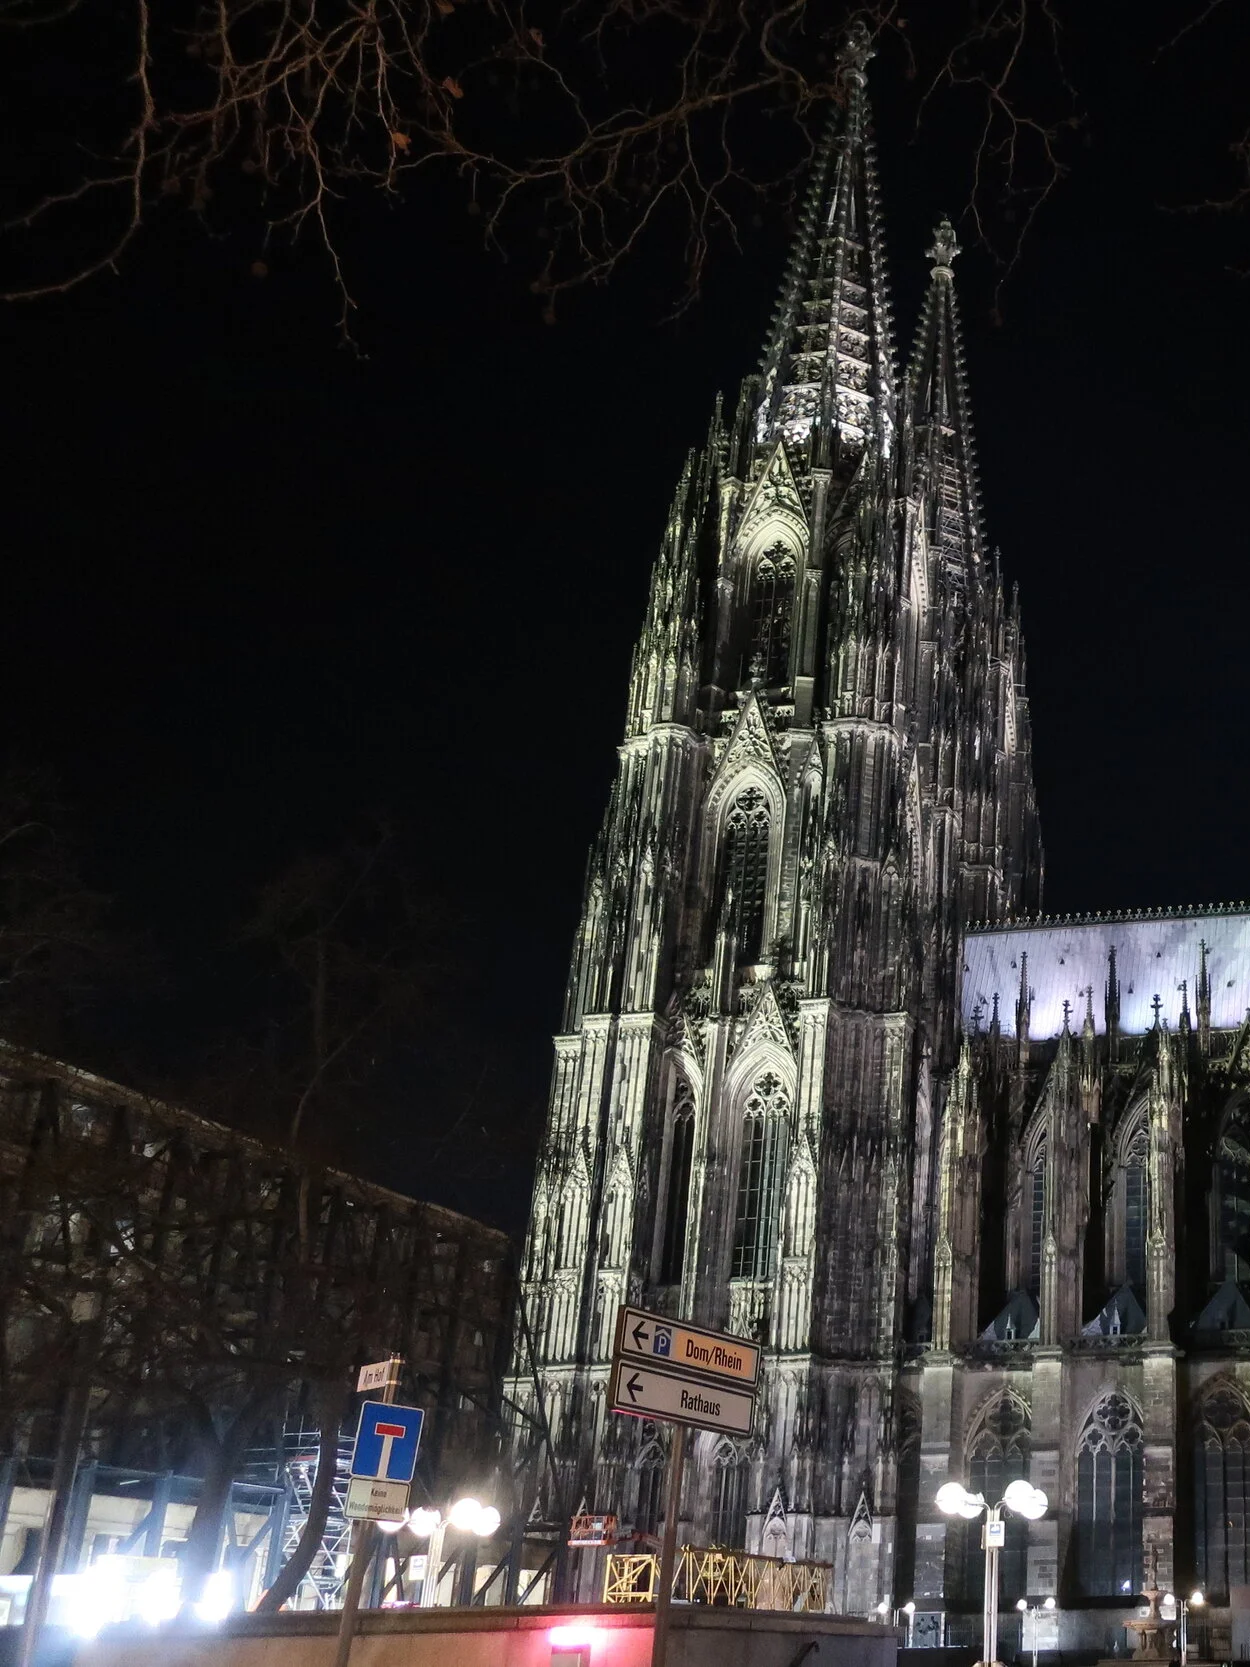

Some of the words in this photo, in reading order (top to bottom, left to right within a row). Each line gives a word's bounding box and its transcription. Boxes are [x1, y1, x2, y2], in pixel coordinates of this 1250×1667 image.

[657, 1335, 667, 1353] P
[685, 1338, 743, 1371] Dom/Rhein
[362, 1370, 373, 1385] Am
[373, 1367, 386, 1383] Hof
[680, 1389, 721, 1416] Rathaus
[370, 1488, 387, 1498] Keine
